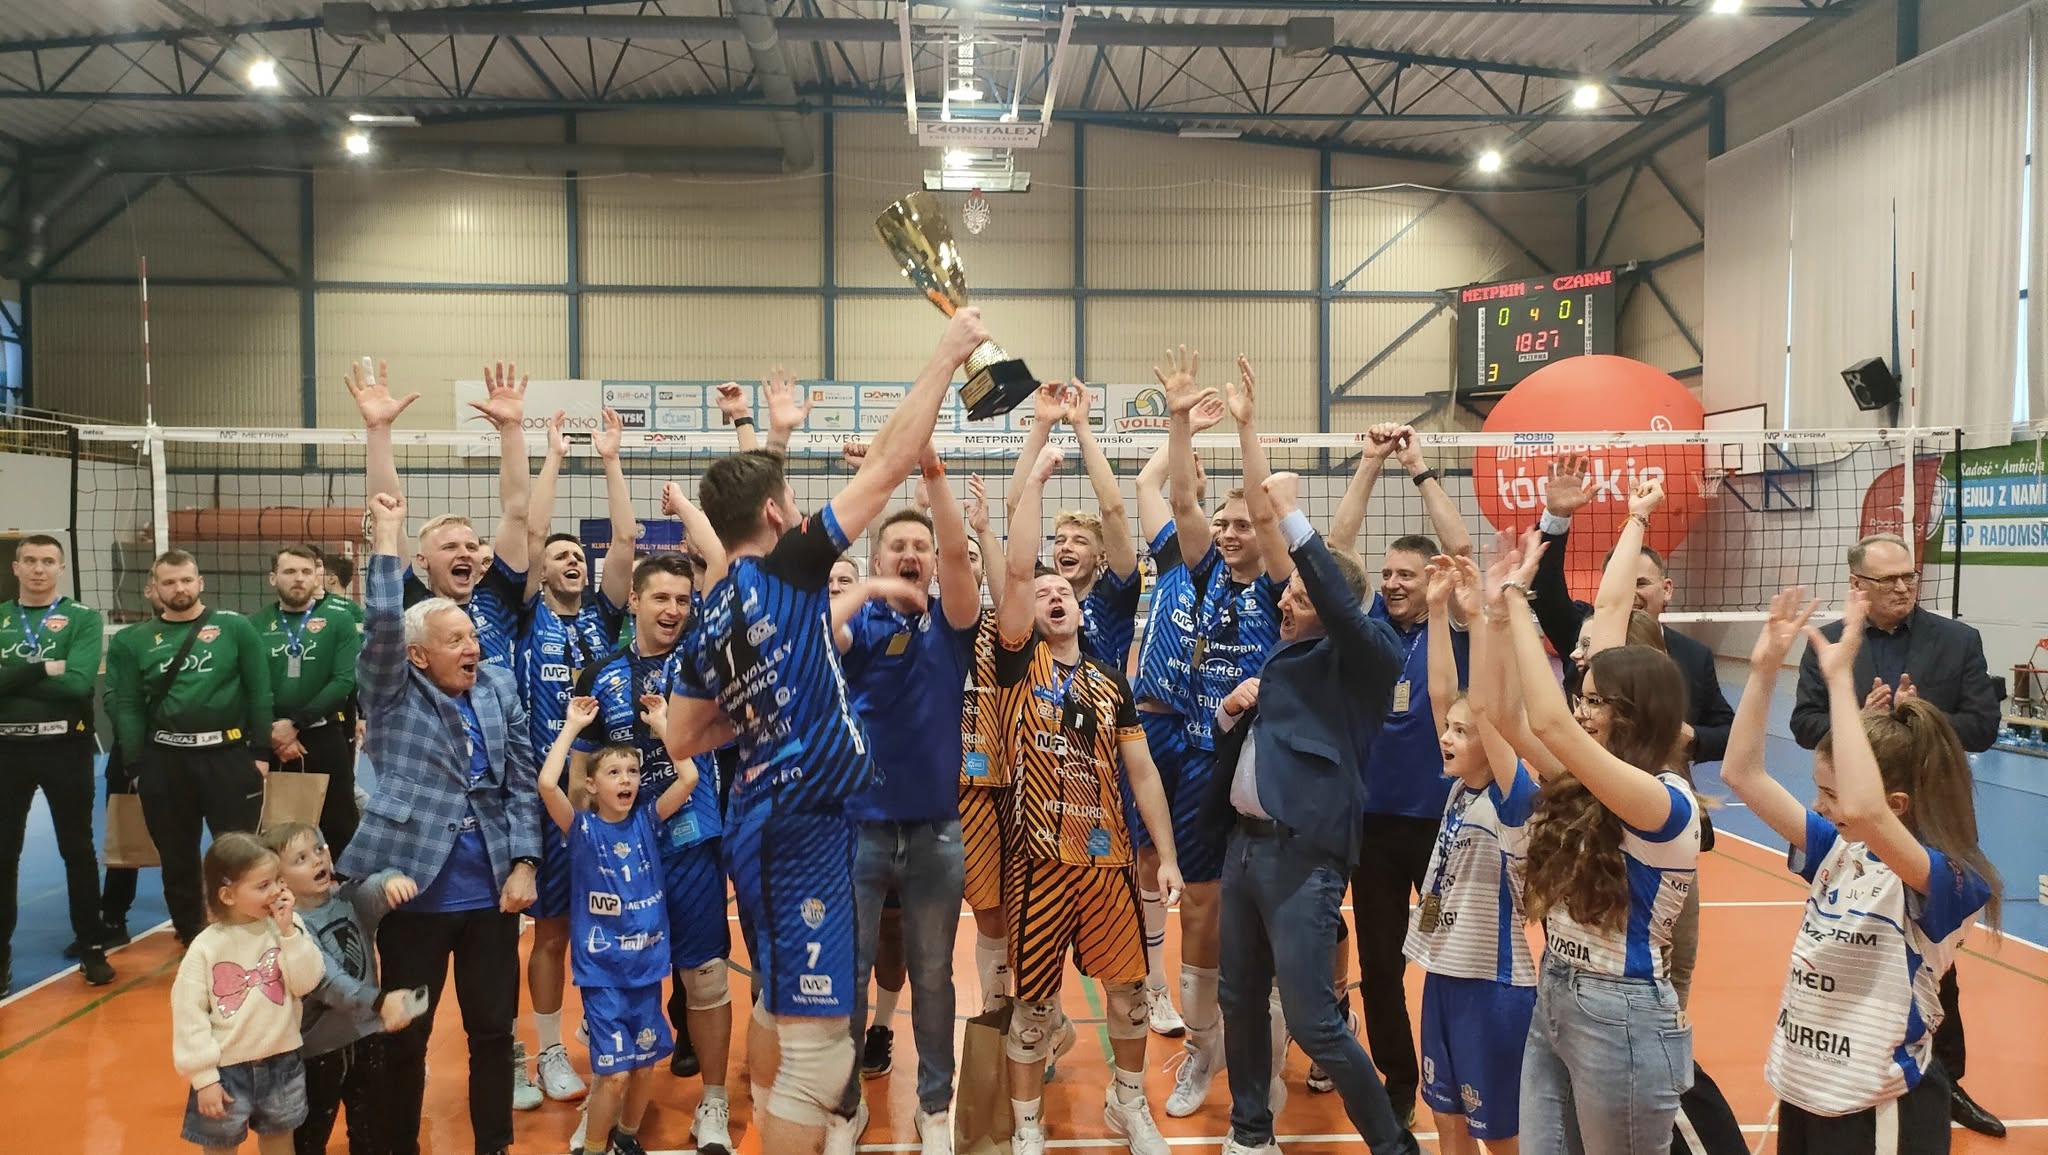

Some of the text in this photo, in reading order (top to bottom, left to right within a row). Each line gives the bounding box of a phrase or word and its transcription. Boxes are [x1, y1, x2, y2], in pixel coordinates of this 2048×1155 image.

[1462, 282, 1526, 303] METPRIM
[1552, 270, 1613, 291] CZARNI
[1498, 299, 1571, 326] 0 4 0
[1519, 353, 1547, 361] PRZERWA
[1487, 363, 1499, 382] 3
[1119, 418, 1171, 430] VOLLE
[964, 435, 1024, 445] METPRIM
[1069, 435, 1133, 445] Romsko
[1514, 432, 1555, 443] PROBUD
[1783, 432, 1827, 440] METPRIM
[1948, 483, 2047, 508] TENUJ Z NAMI
[1979, 523, 2048, 547] RADOMSK
[621, 864, 631, 882] 1
[1802, 921, 1878, 947] MEPRIM
[806, 941, 822, 970] 7
[611, 1030, 624, 1053] 1
[1423, 1055, 1435, 1085] 9
